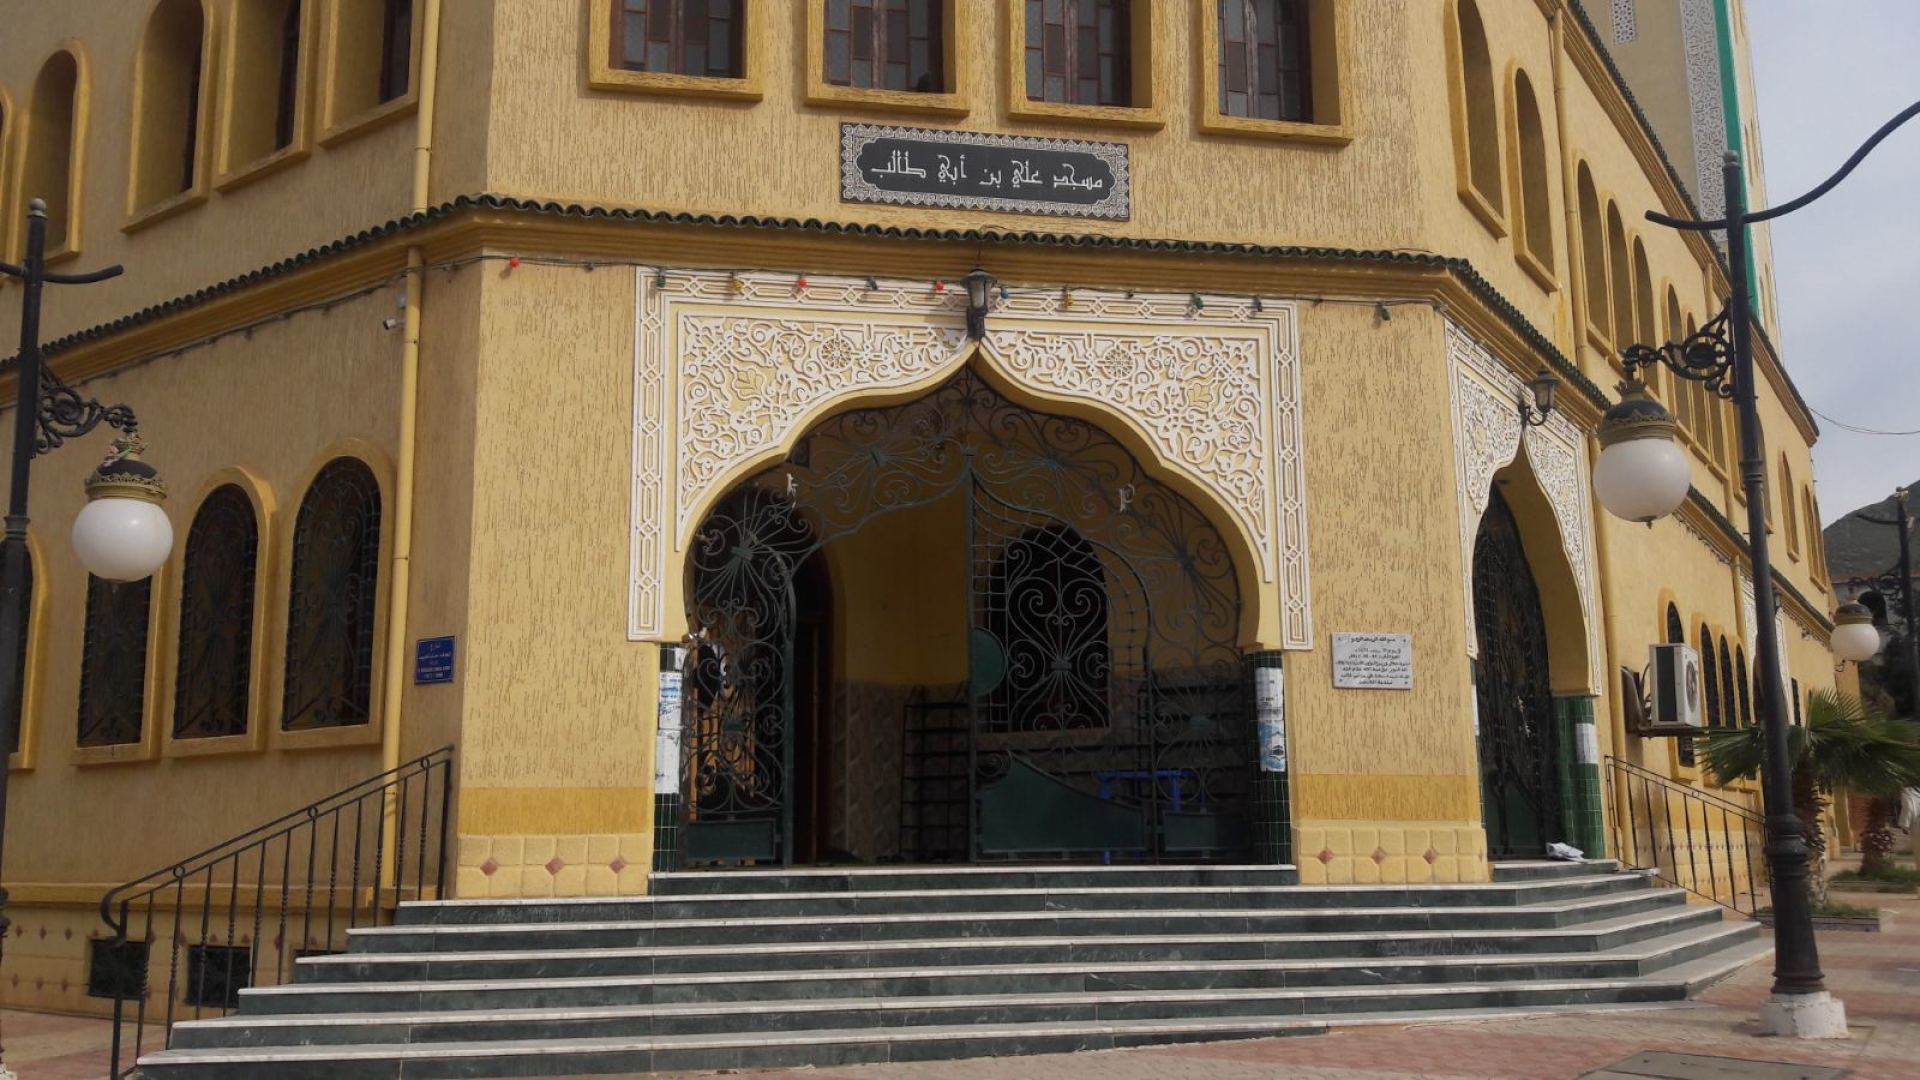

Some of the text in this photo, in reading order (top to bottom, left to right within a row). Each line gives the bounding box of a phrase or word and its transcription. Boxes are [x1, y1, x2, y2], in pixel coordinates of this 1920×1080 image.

[870, 149, 1103, 191] مسجد علي بن أبي طالب
